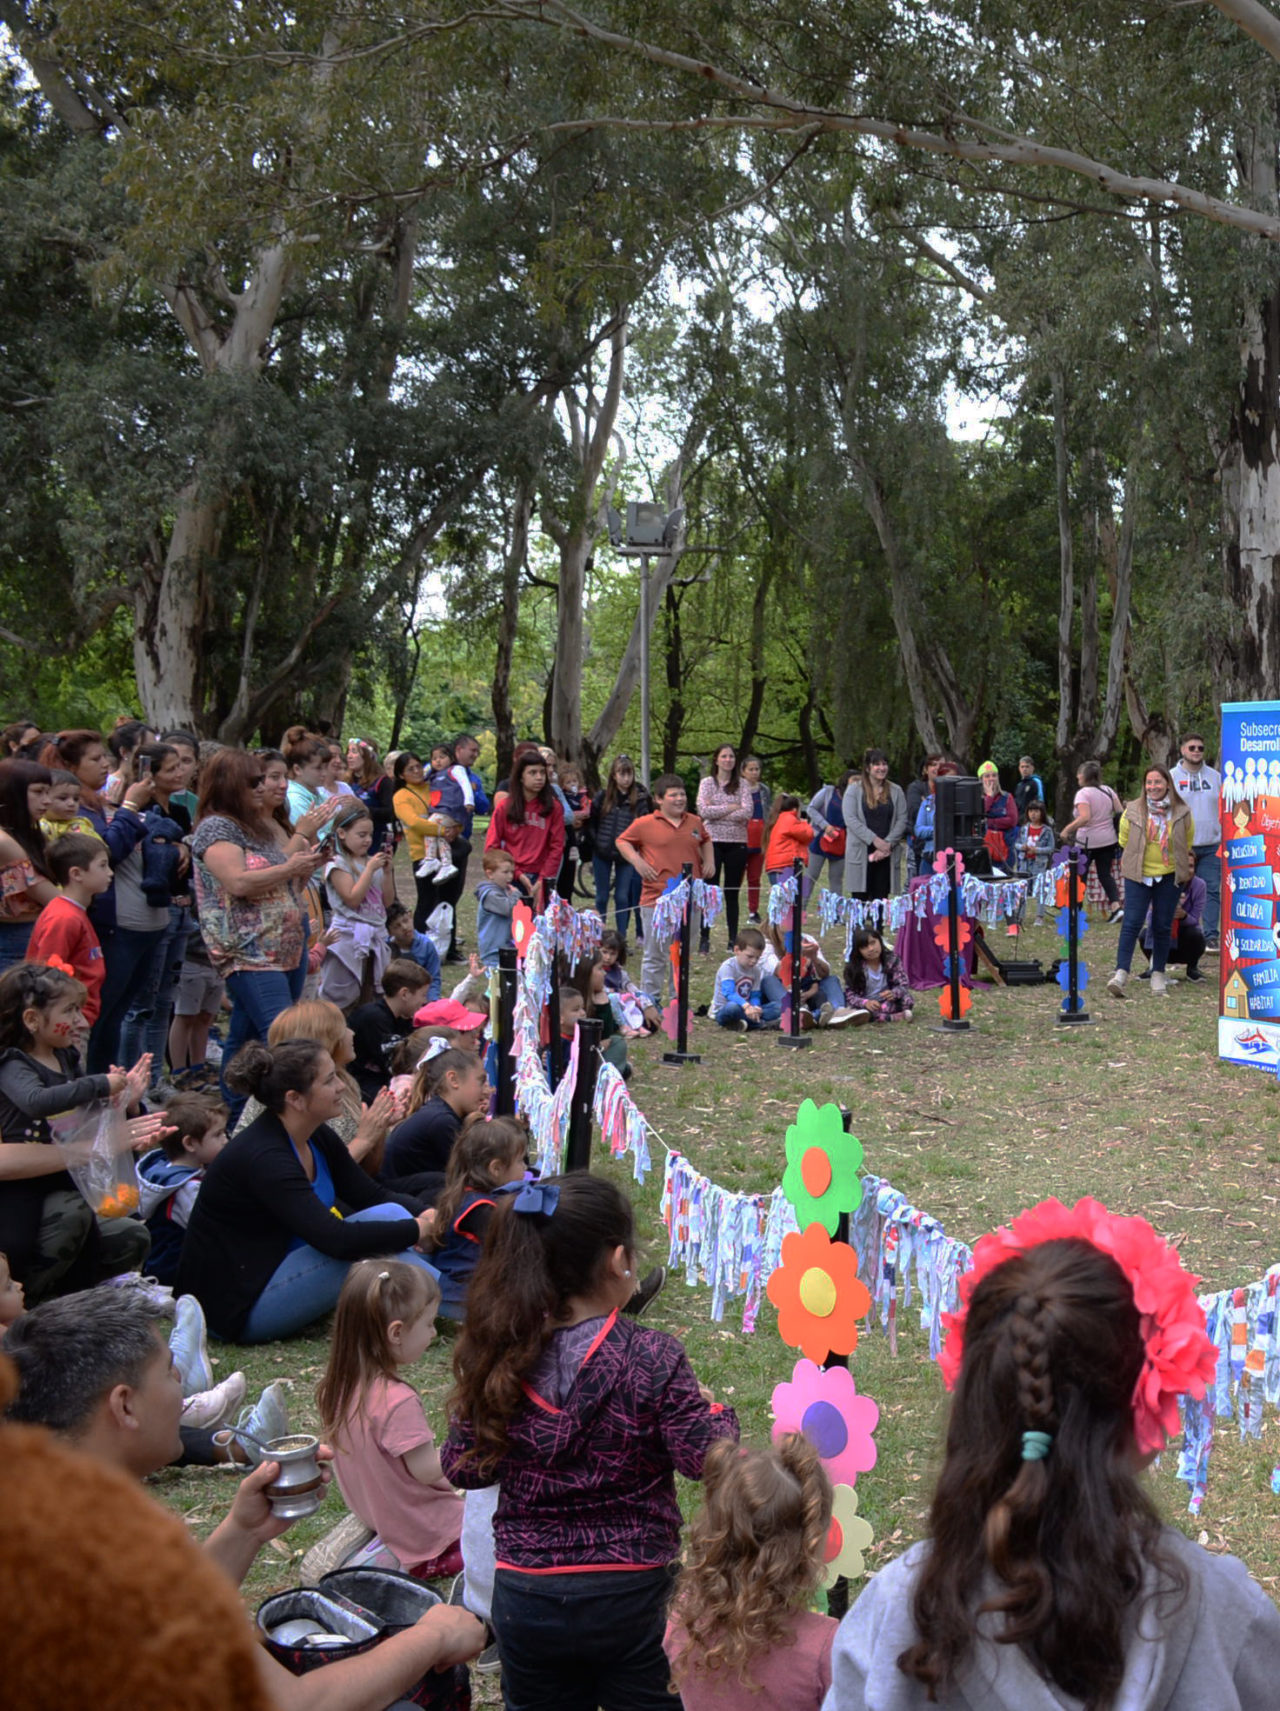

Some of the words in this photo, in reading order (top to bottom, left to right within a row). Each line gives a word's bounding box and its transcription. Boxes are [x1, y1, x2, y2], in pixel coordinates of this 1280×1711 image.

[1179, 781, 1211, 791] FILA
[1238, 876, 1266, 889] IDENTIDAD
[1236, 902, 1263, 920] CULTURA
[1252, 969, 1279, 986] FAMILIA
